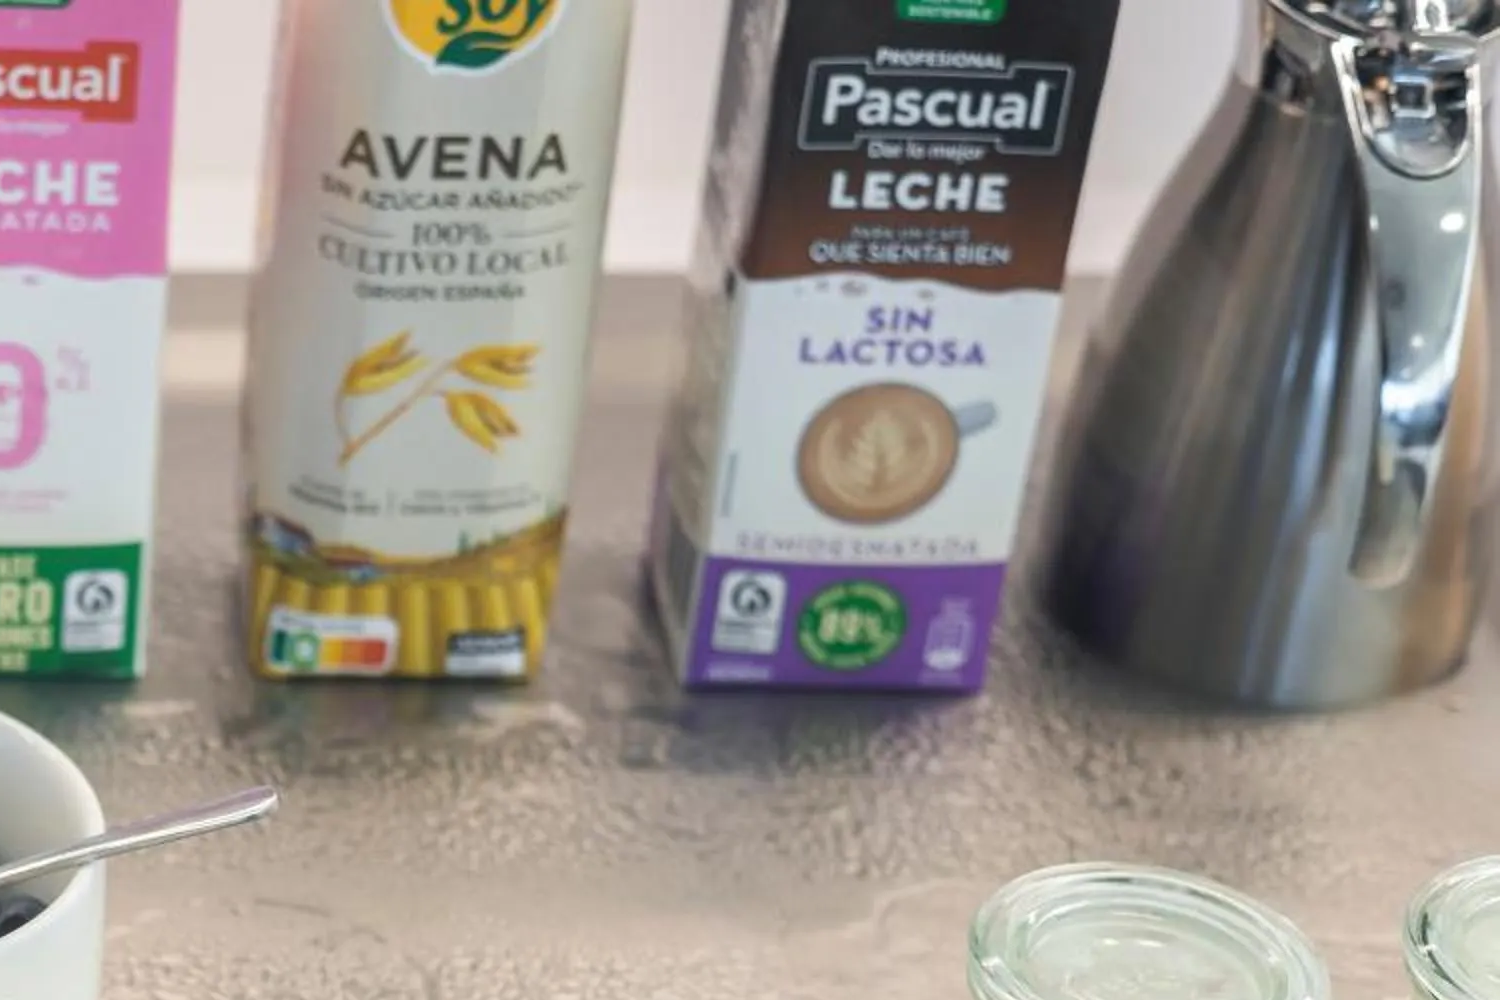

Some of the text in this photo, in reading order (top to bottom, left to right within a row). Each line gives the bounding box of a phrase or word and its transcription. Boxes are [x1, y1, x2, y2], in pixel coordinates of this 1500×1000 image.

[876, 46, 1005, 70] PROFESIONAL
[821, 74, 1048, 130] Pascual
[338, 128, 568, 181] AVENA
[867, 141, 903, 159] Dar
[928, 143, 987, 165] mejor
[828, 170, 1010, 212] LECHE
[412, 221, 492, 247] 100%
[318, 233, 569, 276] CULTIVO LOCAL
[808, 240, 1012, 266] QUE SIENTA BIEN
[866, 305, 934, 335] SIN
[798, 337, 986, 368] LACTOSA
